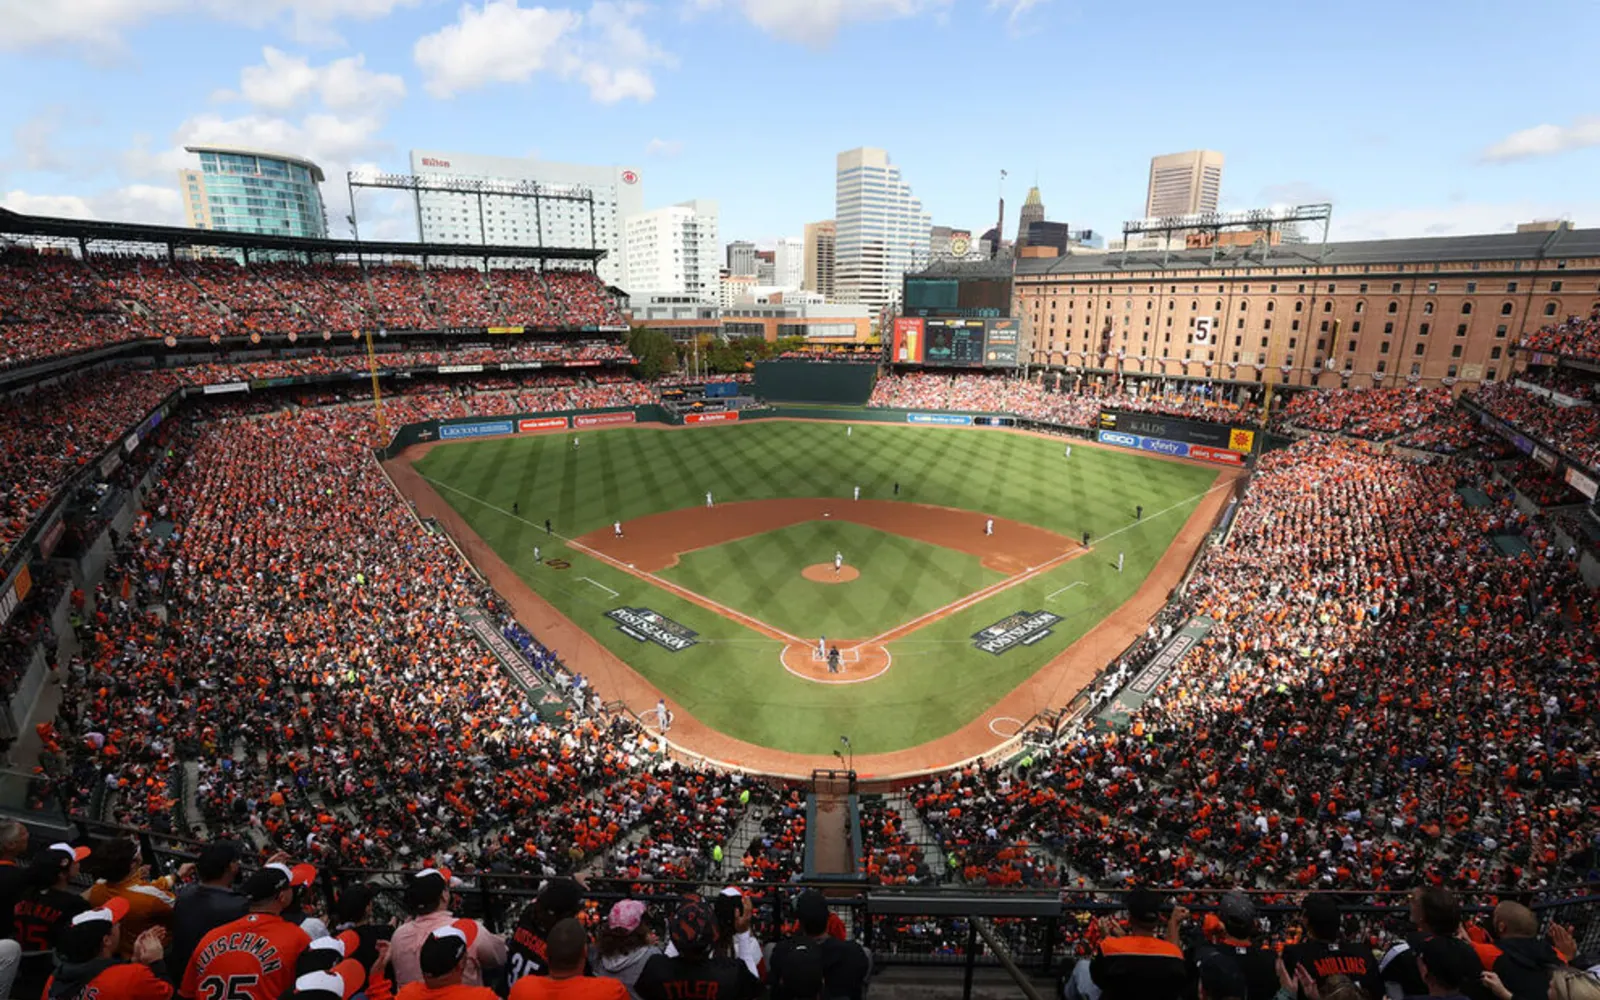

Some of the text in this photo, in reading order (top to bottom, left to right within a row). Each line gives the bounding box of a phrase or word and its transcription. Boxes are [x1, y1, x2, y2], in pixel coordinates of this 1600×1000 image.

[422, 157, 450, 168] Hilton
[1196, 320, 1208, 341] 5
[611, 609, 691, 649] POSTSEASON
[981, 613, 1056, 652] POSTSEASON
[196, 932, 282, 976] RUTSCHMAN
[1313, 956, 1367, 977] MULLINS
[663, 980, 719, 1000] TYLER
